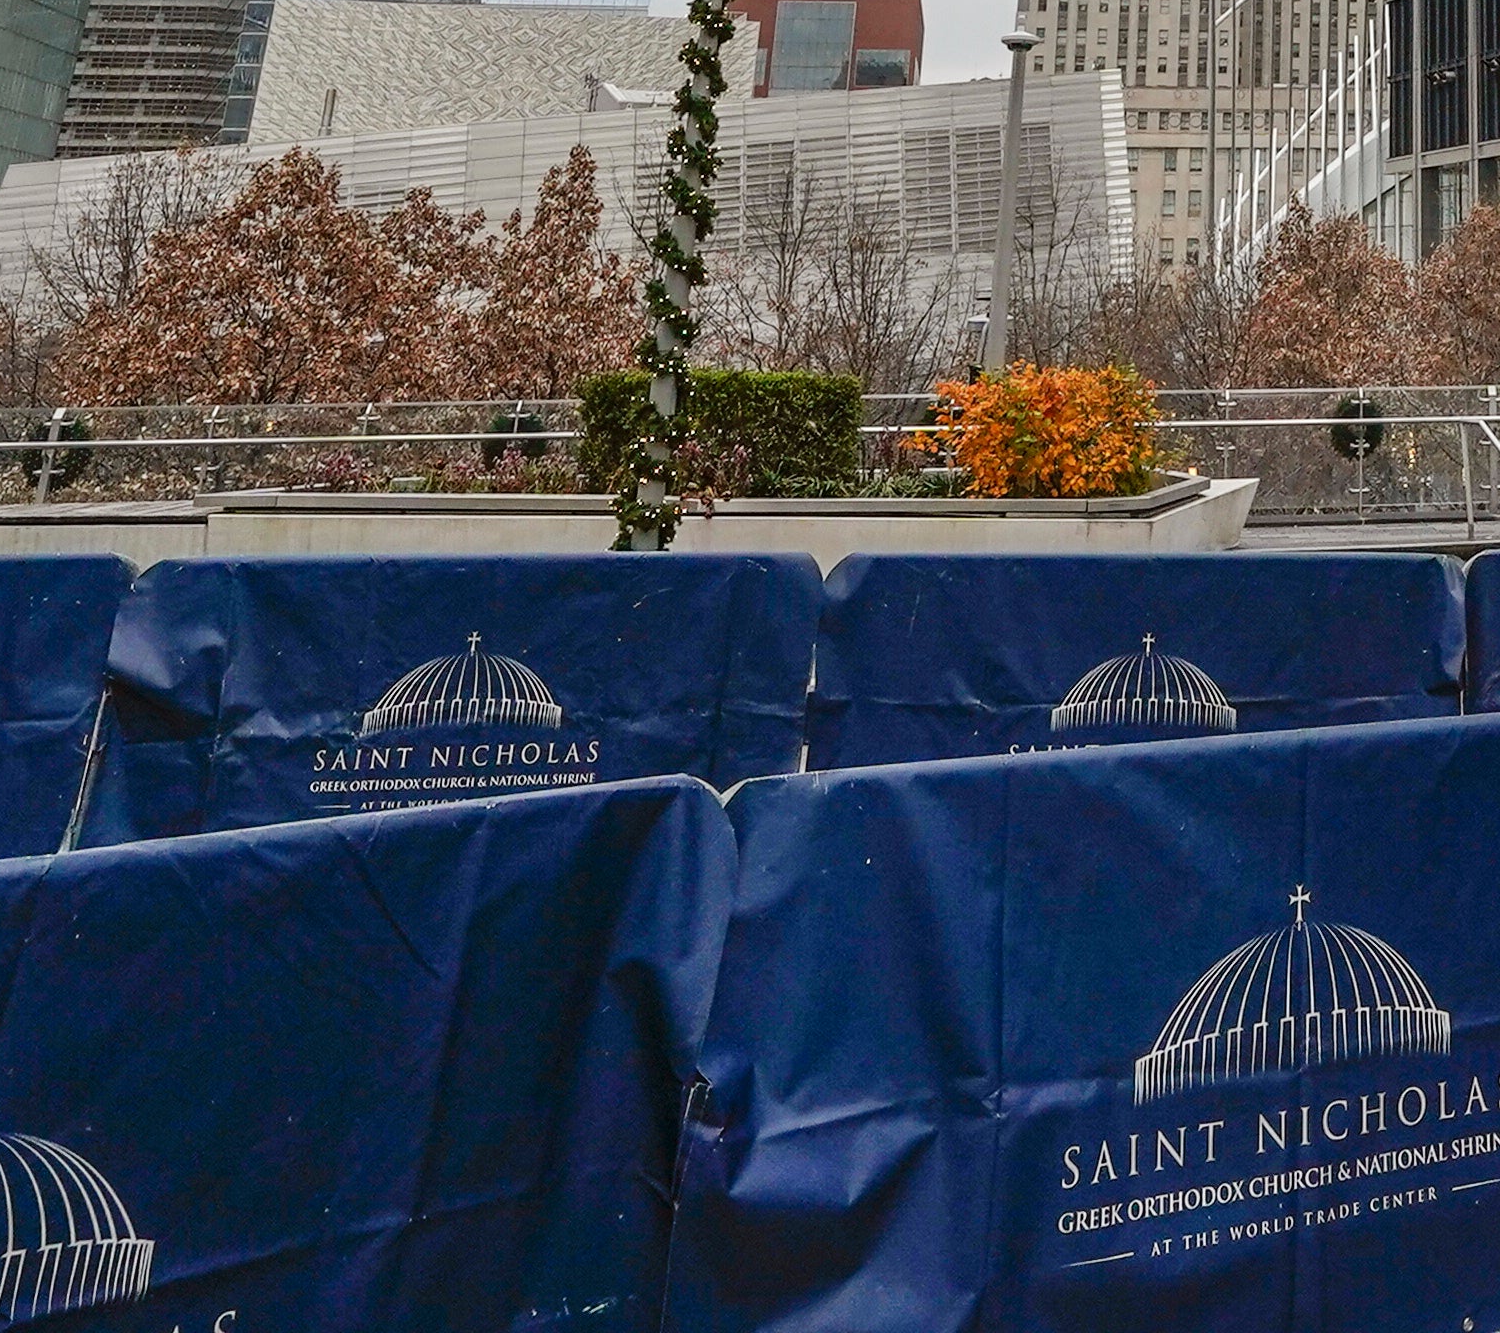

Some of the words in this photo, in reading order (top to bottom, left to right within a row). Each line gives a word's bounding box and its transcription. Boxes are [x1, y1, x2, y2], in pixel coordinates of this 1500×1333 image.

[313, 747, 414, 772] SAINT
[431, 741, 600, 767] NICHOLAS
[310, 781, 348, 793] GREEK
[350, 778, 421, 792] ORTHODOX
[423, 776, 475, 789] CHURCH
[477, 776, 487, 787] &
[490, 773, 550, 786] NATIONAL
[552, 772, 596, 784] SHRINE
[361, 801, 375, 810] AT
[380, 800, 402, 809] THE
[1060, 1120, 1225, 1190] SAINT
[1058, 1203, 1124, 1234] GREEK
[1127, 1178, 1245, 1221] ORTHODOX
[1249, 1164, 1333, 1201] CHURCH
[1337, 1161, 1351, 1182] &
[1354, 1141, 1449, 1179] NATIONAL
[1150, 1236, 1173, 1258] AT
[1181, 1229, 1220, 1252] THE
[1228, 1215, 1295, 1242] WORLD
[1303, 1201, 1361, 1227] TRADE
[1369, 1185, 1438, 1213] CENTER
